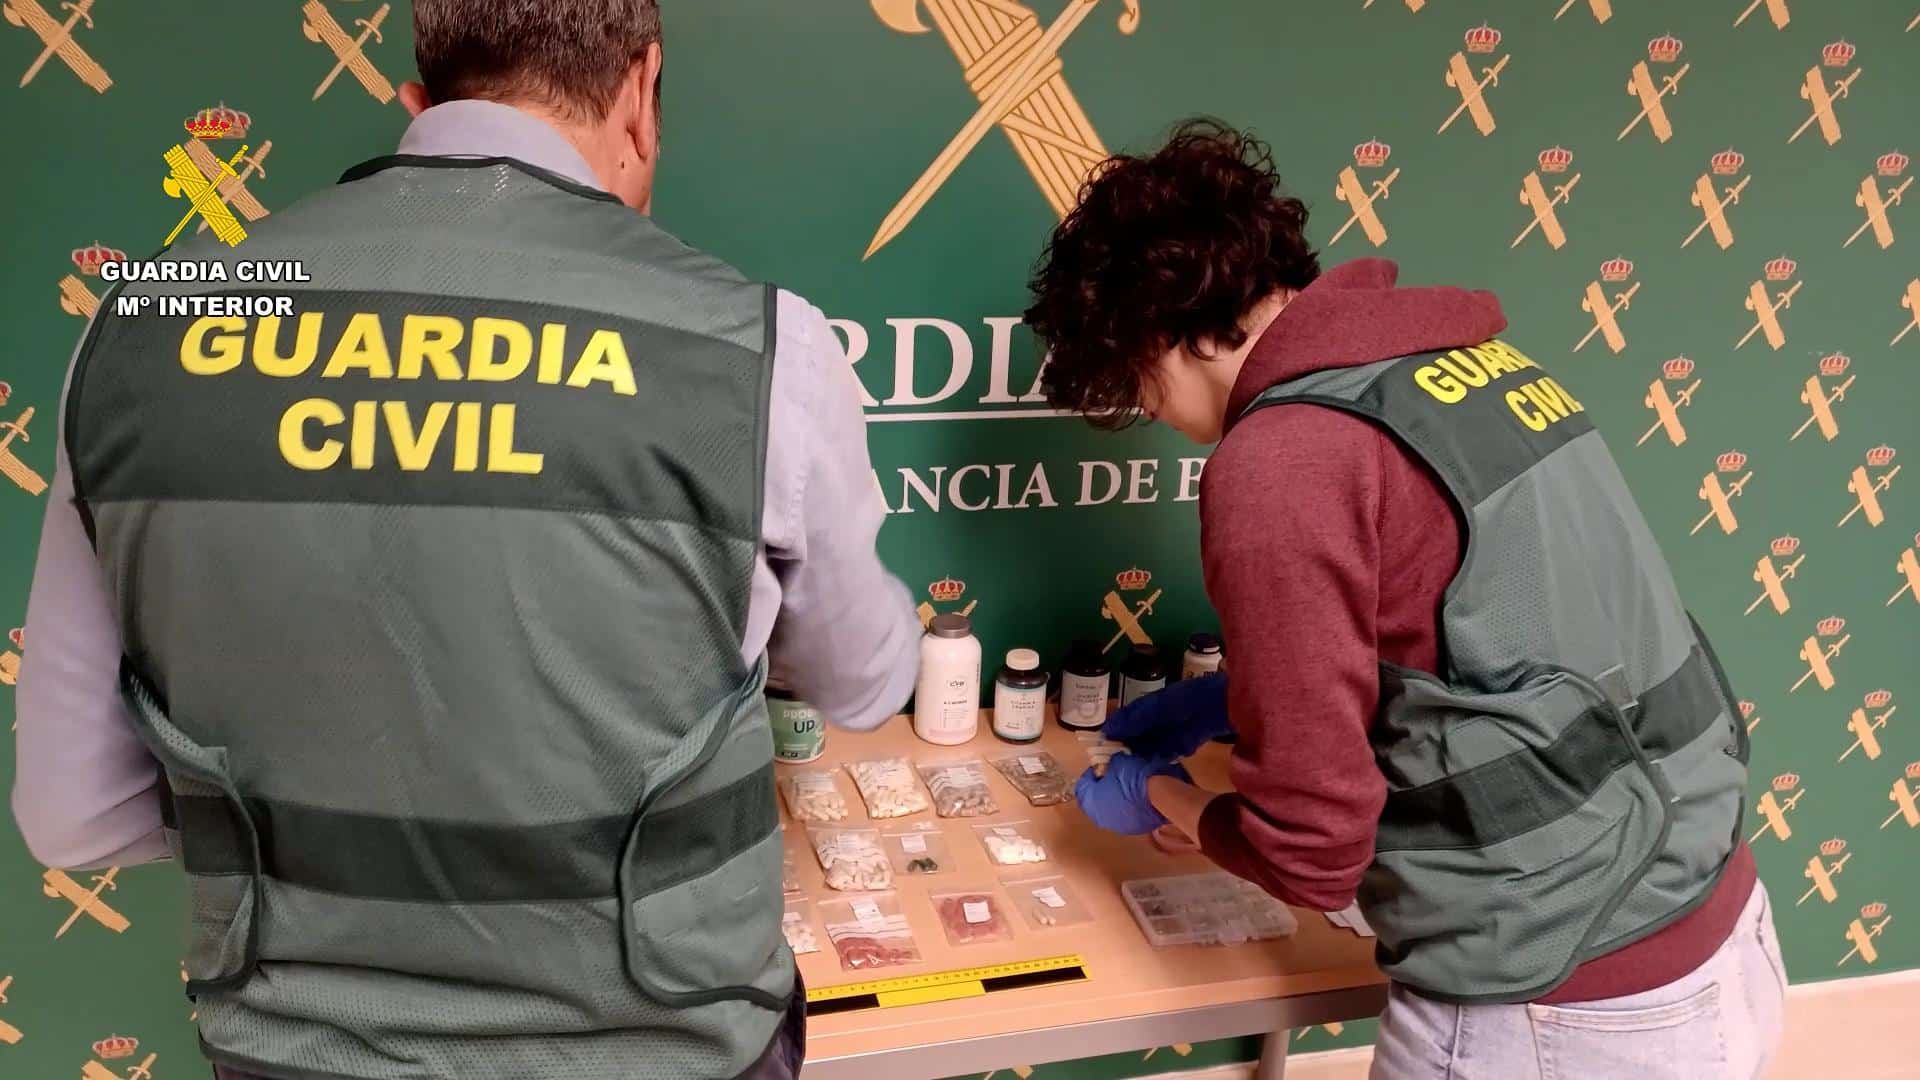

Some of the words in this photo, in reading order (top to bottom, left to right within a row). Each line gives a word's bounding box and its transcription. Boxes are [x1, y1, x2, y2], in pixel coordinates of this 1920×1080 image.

[180, 314, 638, 396] GUARDIA
[825, 316, 1049, 407] RDI
[278, 398, 544, 475] CIVIL
[1075, 458, 1160, 507] DE
